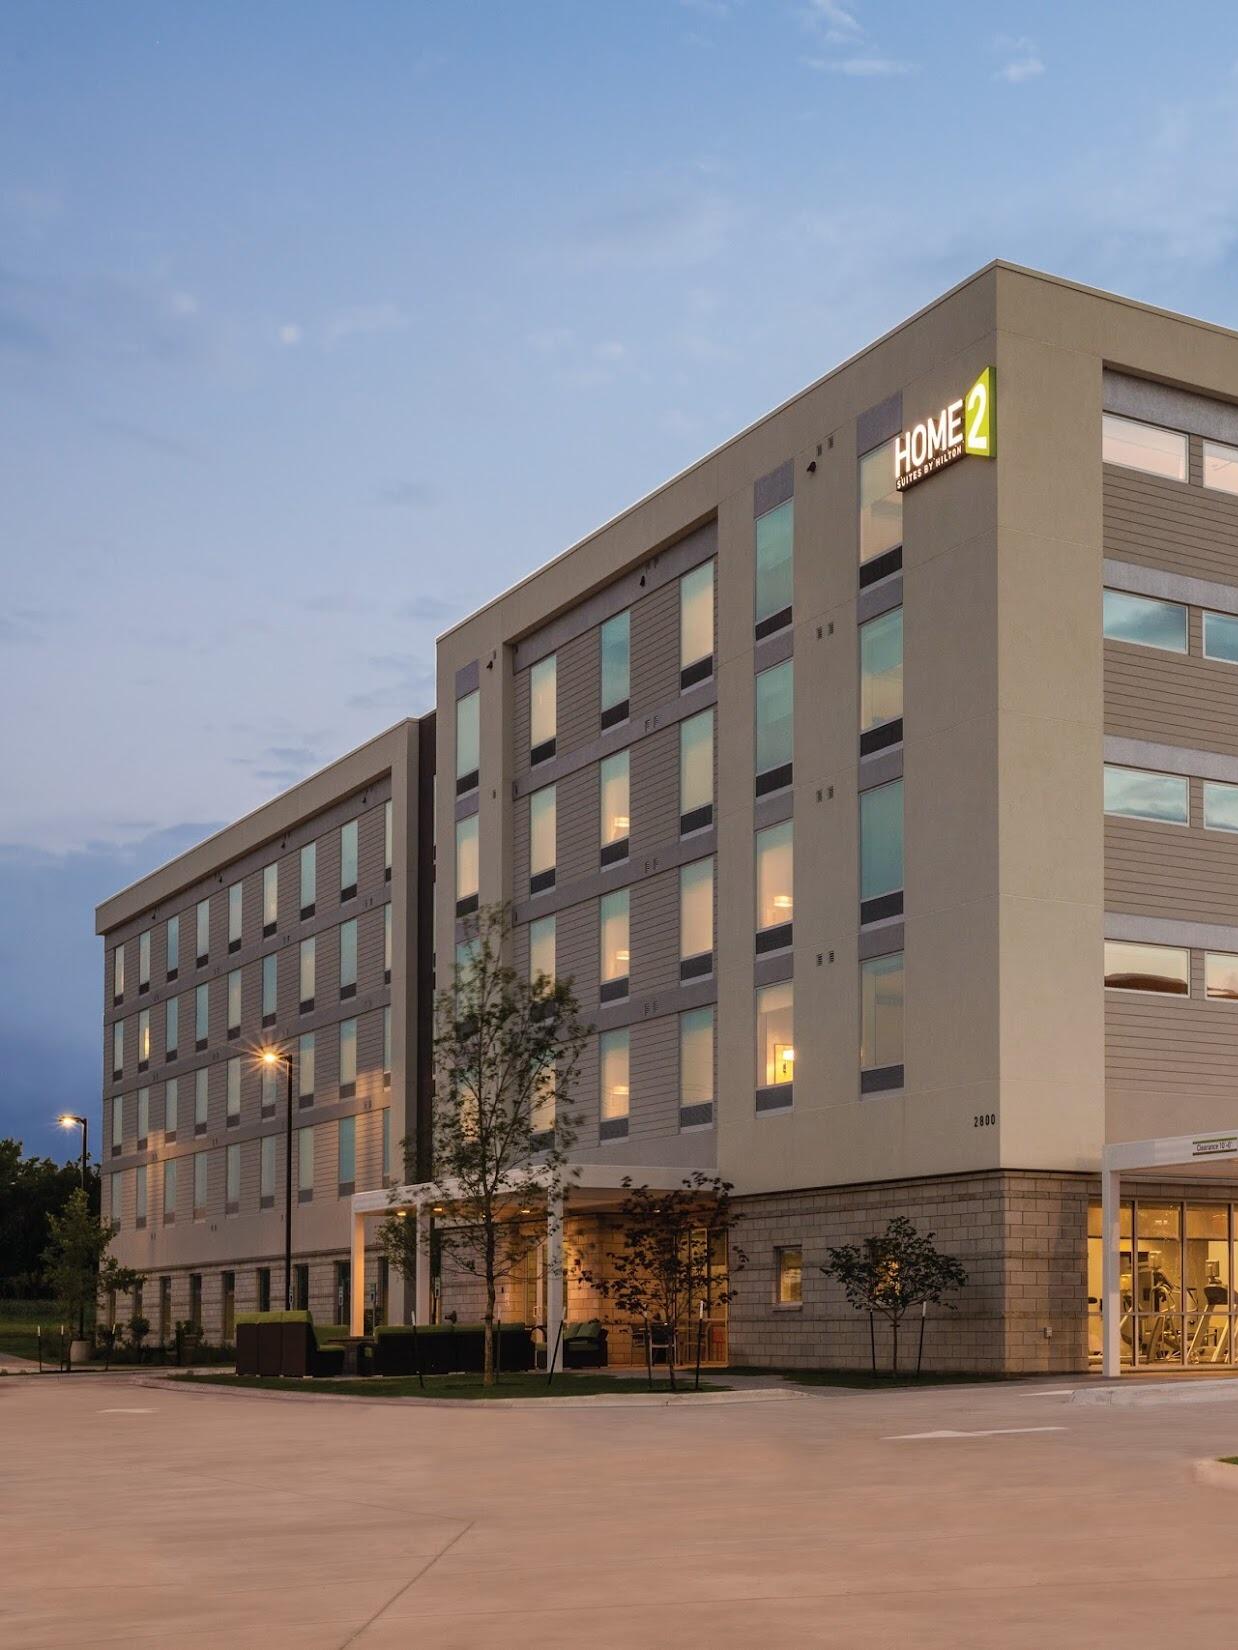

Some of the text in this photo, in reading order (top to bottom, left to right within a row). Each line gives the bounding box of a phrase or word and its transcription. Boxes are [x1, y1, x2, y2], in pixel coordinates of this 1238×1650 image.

[895, 383, 987, 479] HOME 2
[897, 445, 962, 489] SUITES BY HILTON
[974, 1114, 995, 1127] 2800
